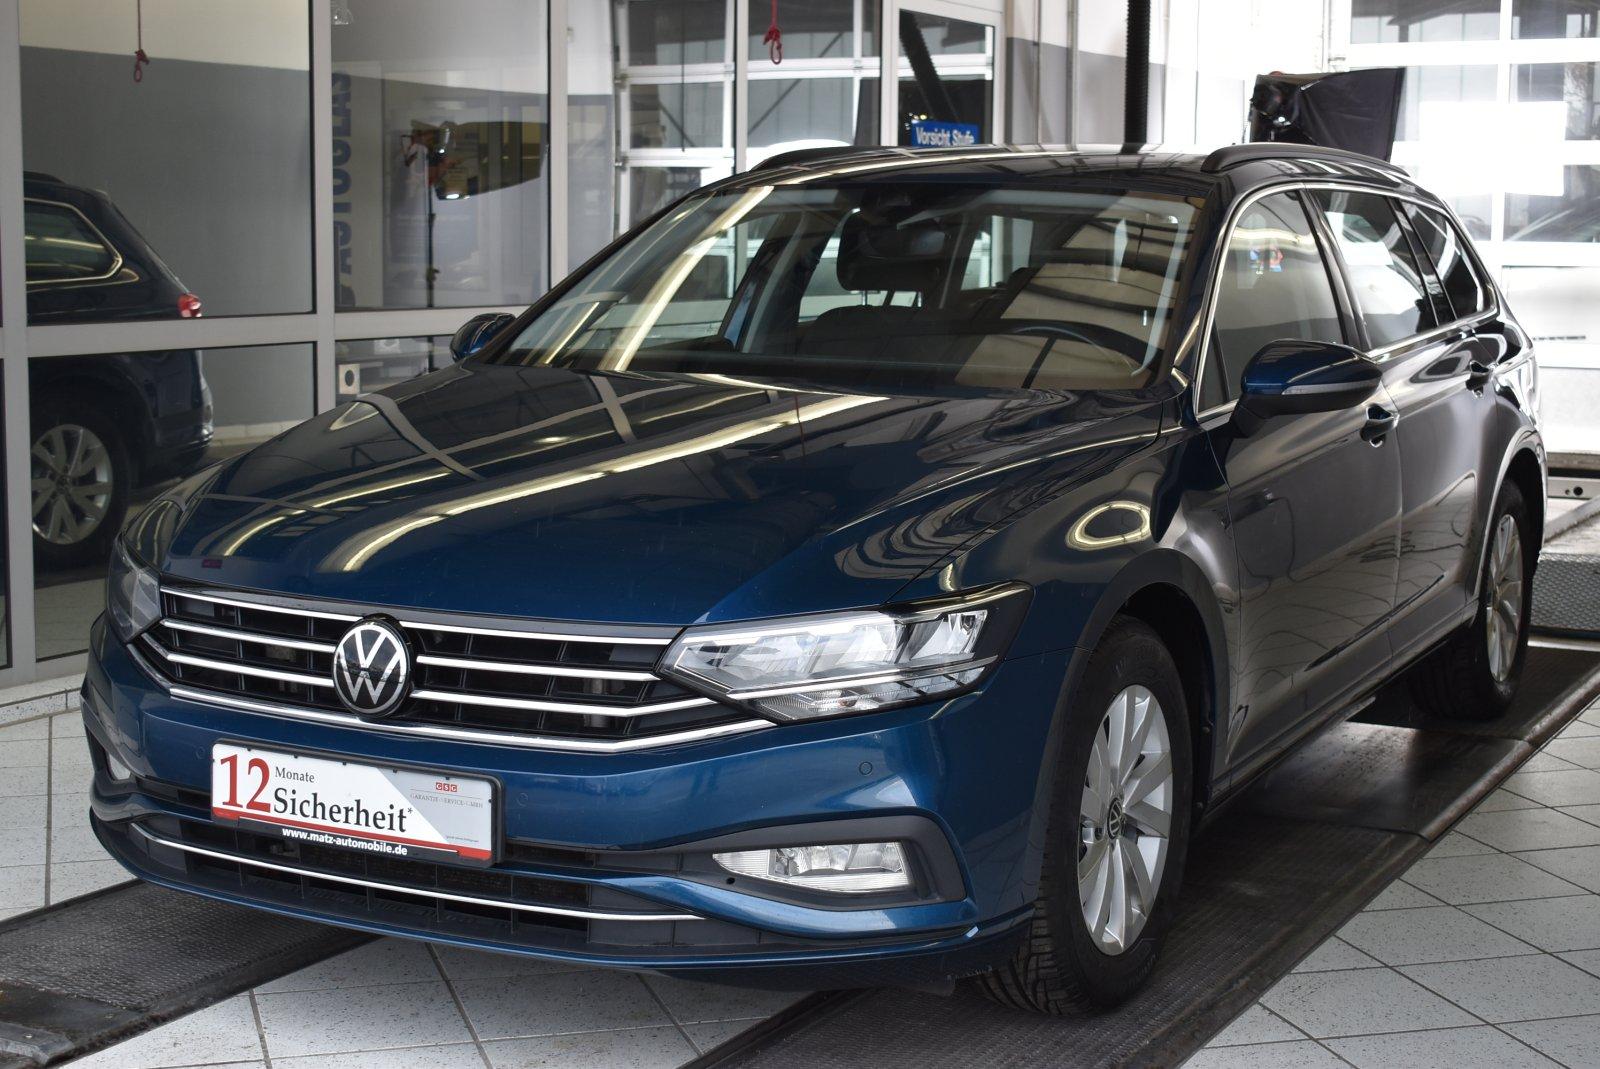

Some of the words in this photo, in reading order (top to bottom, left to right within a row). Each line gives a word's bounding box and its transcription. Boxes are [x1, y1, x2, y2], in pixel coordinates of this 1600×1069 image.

[915, 127, 951, 146] Vorsicht
[952, 129, 975, 146] Stufe
[220, 753, 271, 813] 12
[275, 766, 315, 783] Monate
[282, 826, 408, 856] www.matz-automobile.de
